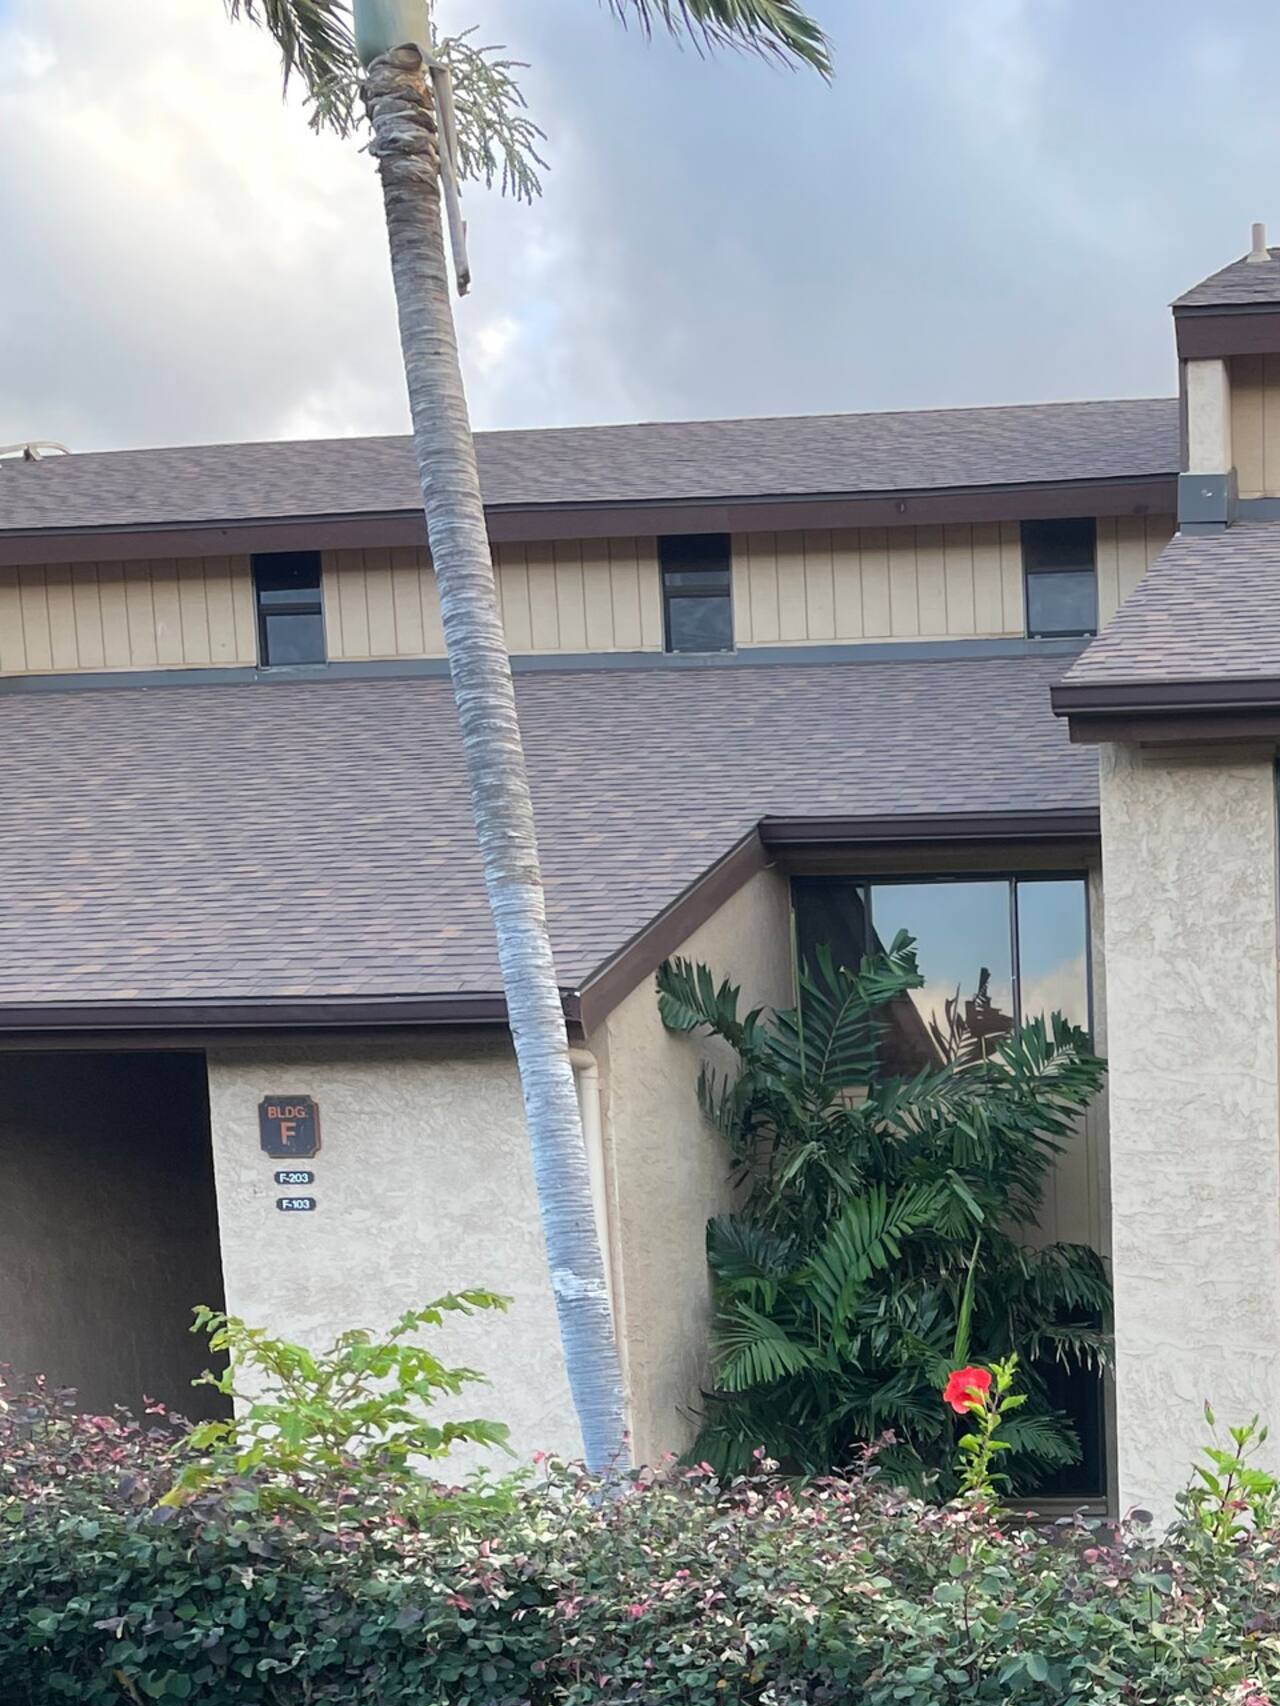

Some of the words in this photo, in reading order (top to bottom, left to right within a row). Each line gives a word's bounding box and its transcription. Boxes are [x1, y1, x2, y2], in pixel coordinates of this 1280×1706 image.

[281, 1122, 296, 1145] F
[279, 1173, 309, 1183] F-203
[282, 1200, 310, 1209] F-103
